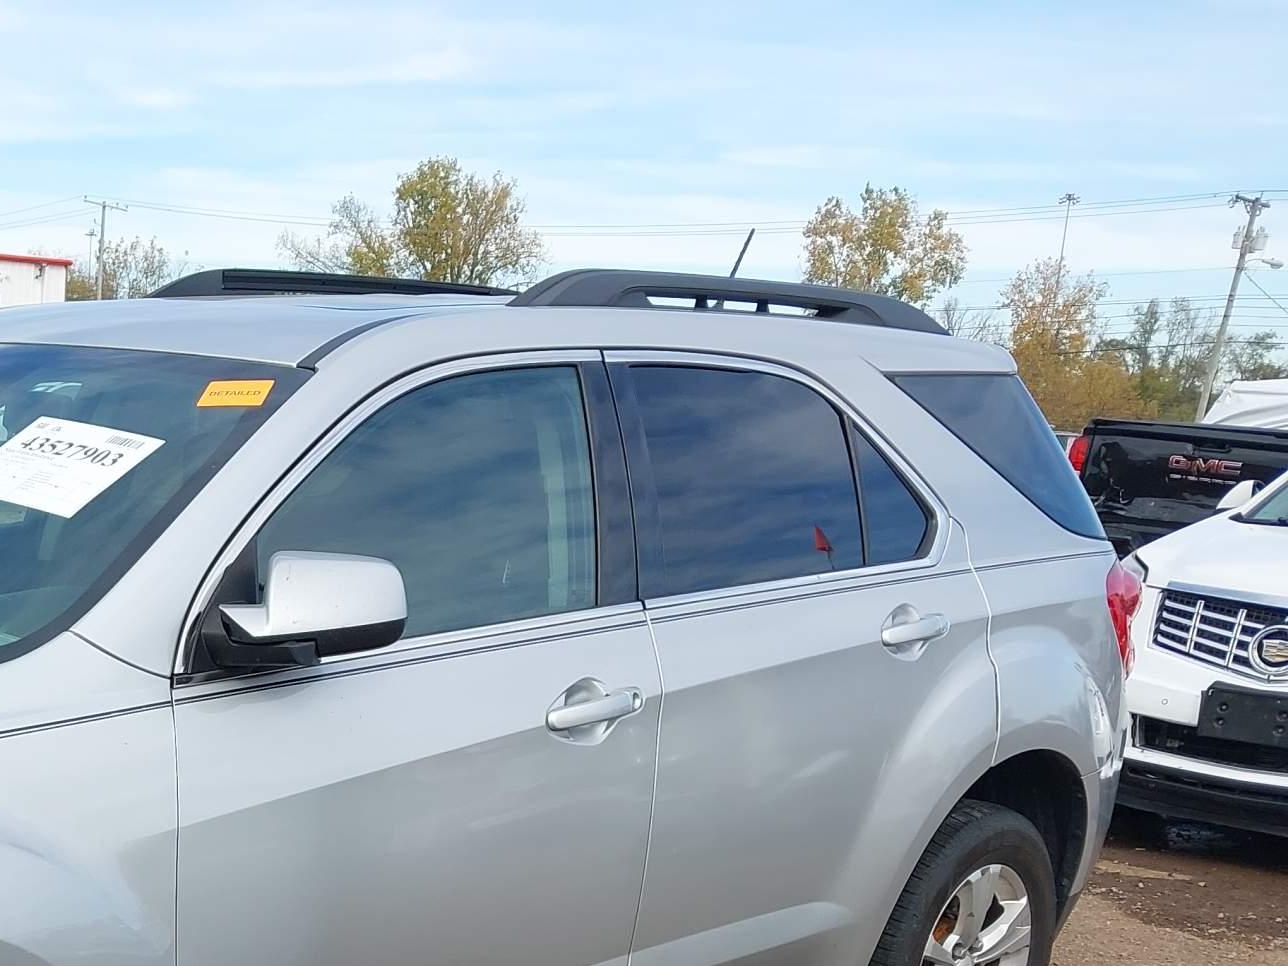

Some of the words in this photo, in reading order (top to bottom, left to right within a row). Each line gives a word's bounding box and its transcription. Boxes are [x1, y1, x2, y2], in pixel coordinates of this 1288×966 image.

[208, 389, 262, 397] DETAILED
[21, 435, 124, 468] 43527903
[1169, 455, 1243, 475] GMC
